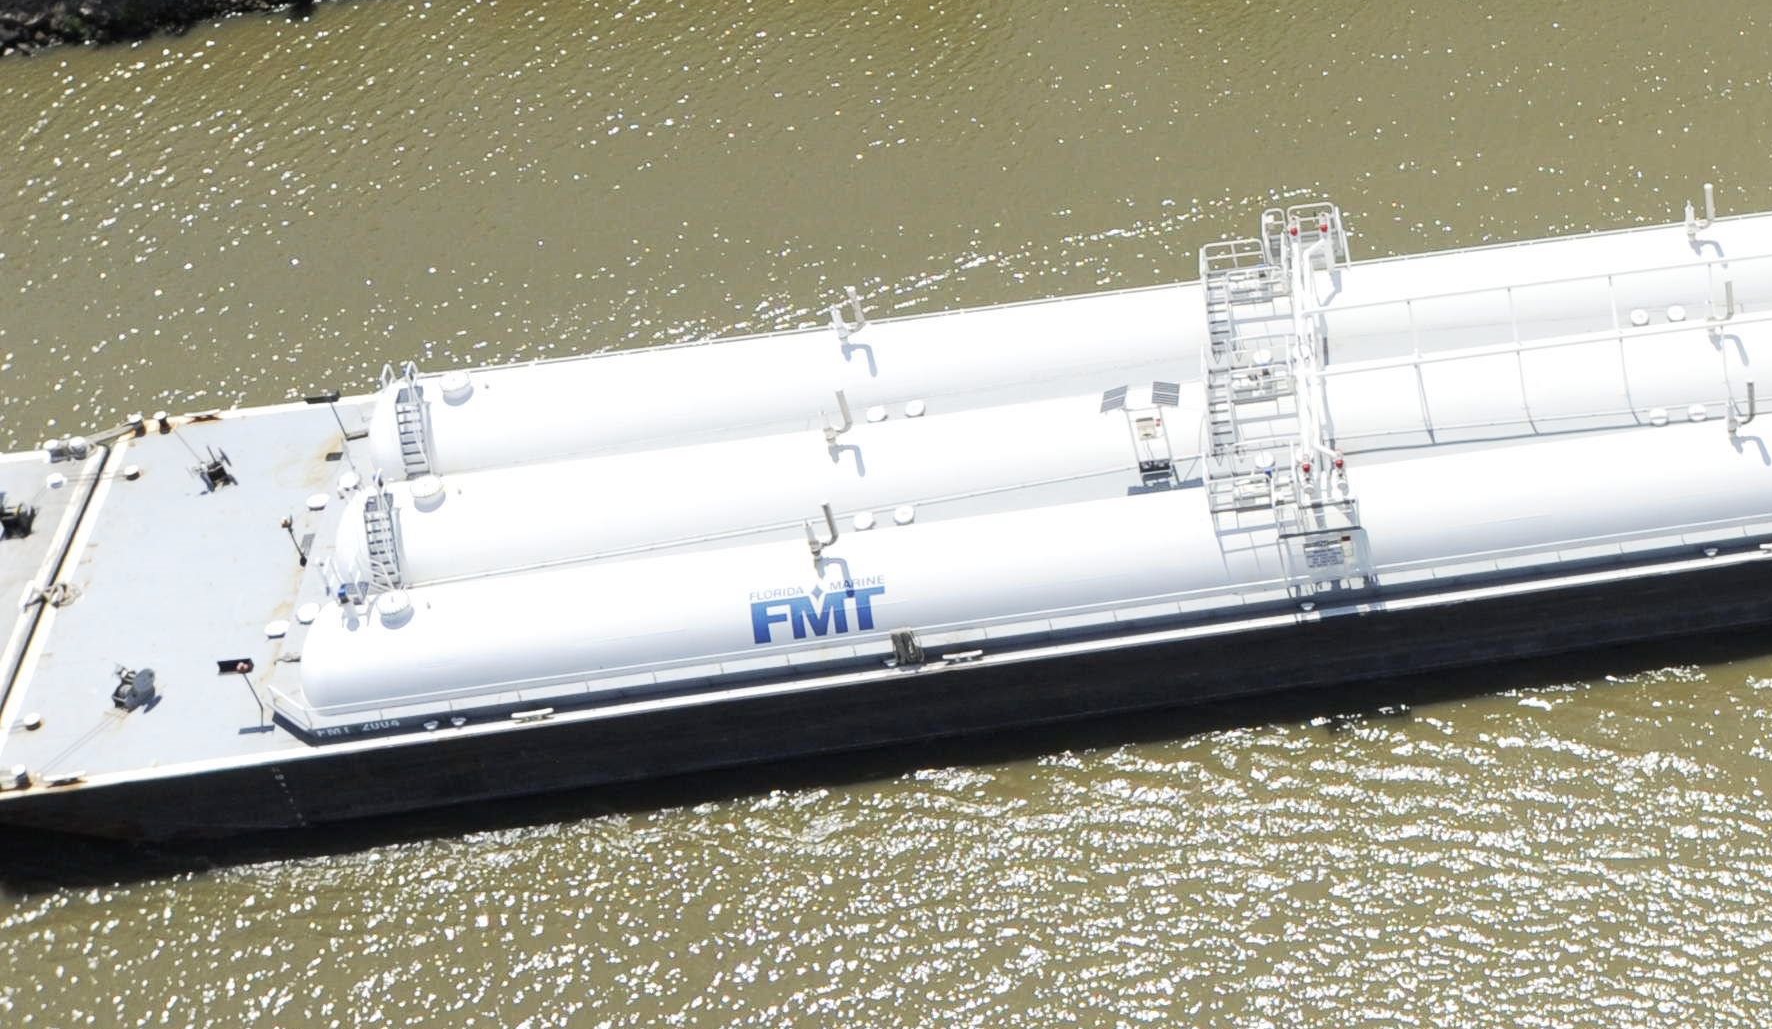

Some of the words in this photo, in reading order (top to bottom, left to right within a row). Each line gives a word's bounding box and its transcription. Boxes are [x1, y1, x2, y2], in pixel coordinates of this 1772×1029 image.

[750, 586, 804, 600] FLORIDA
[830, 575, 885, 590] MARINE
[751, 586, 885, 644] FMT
